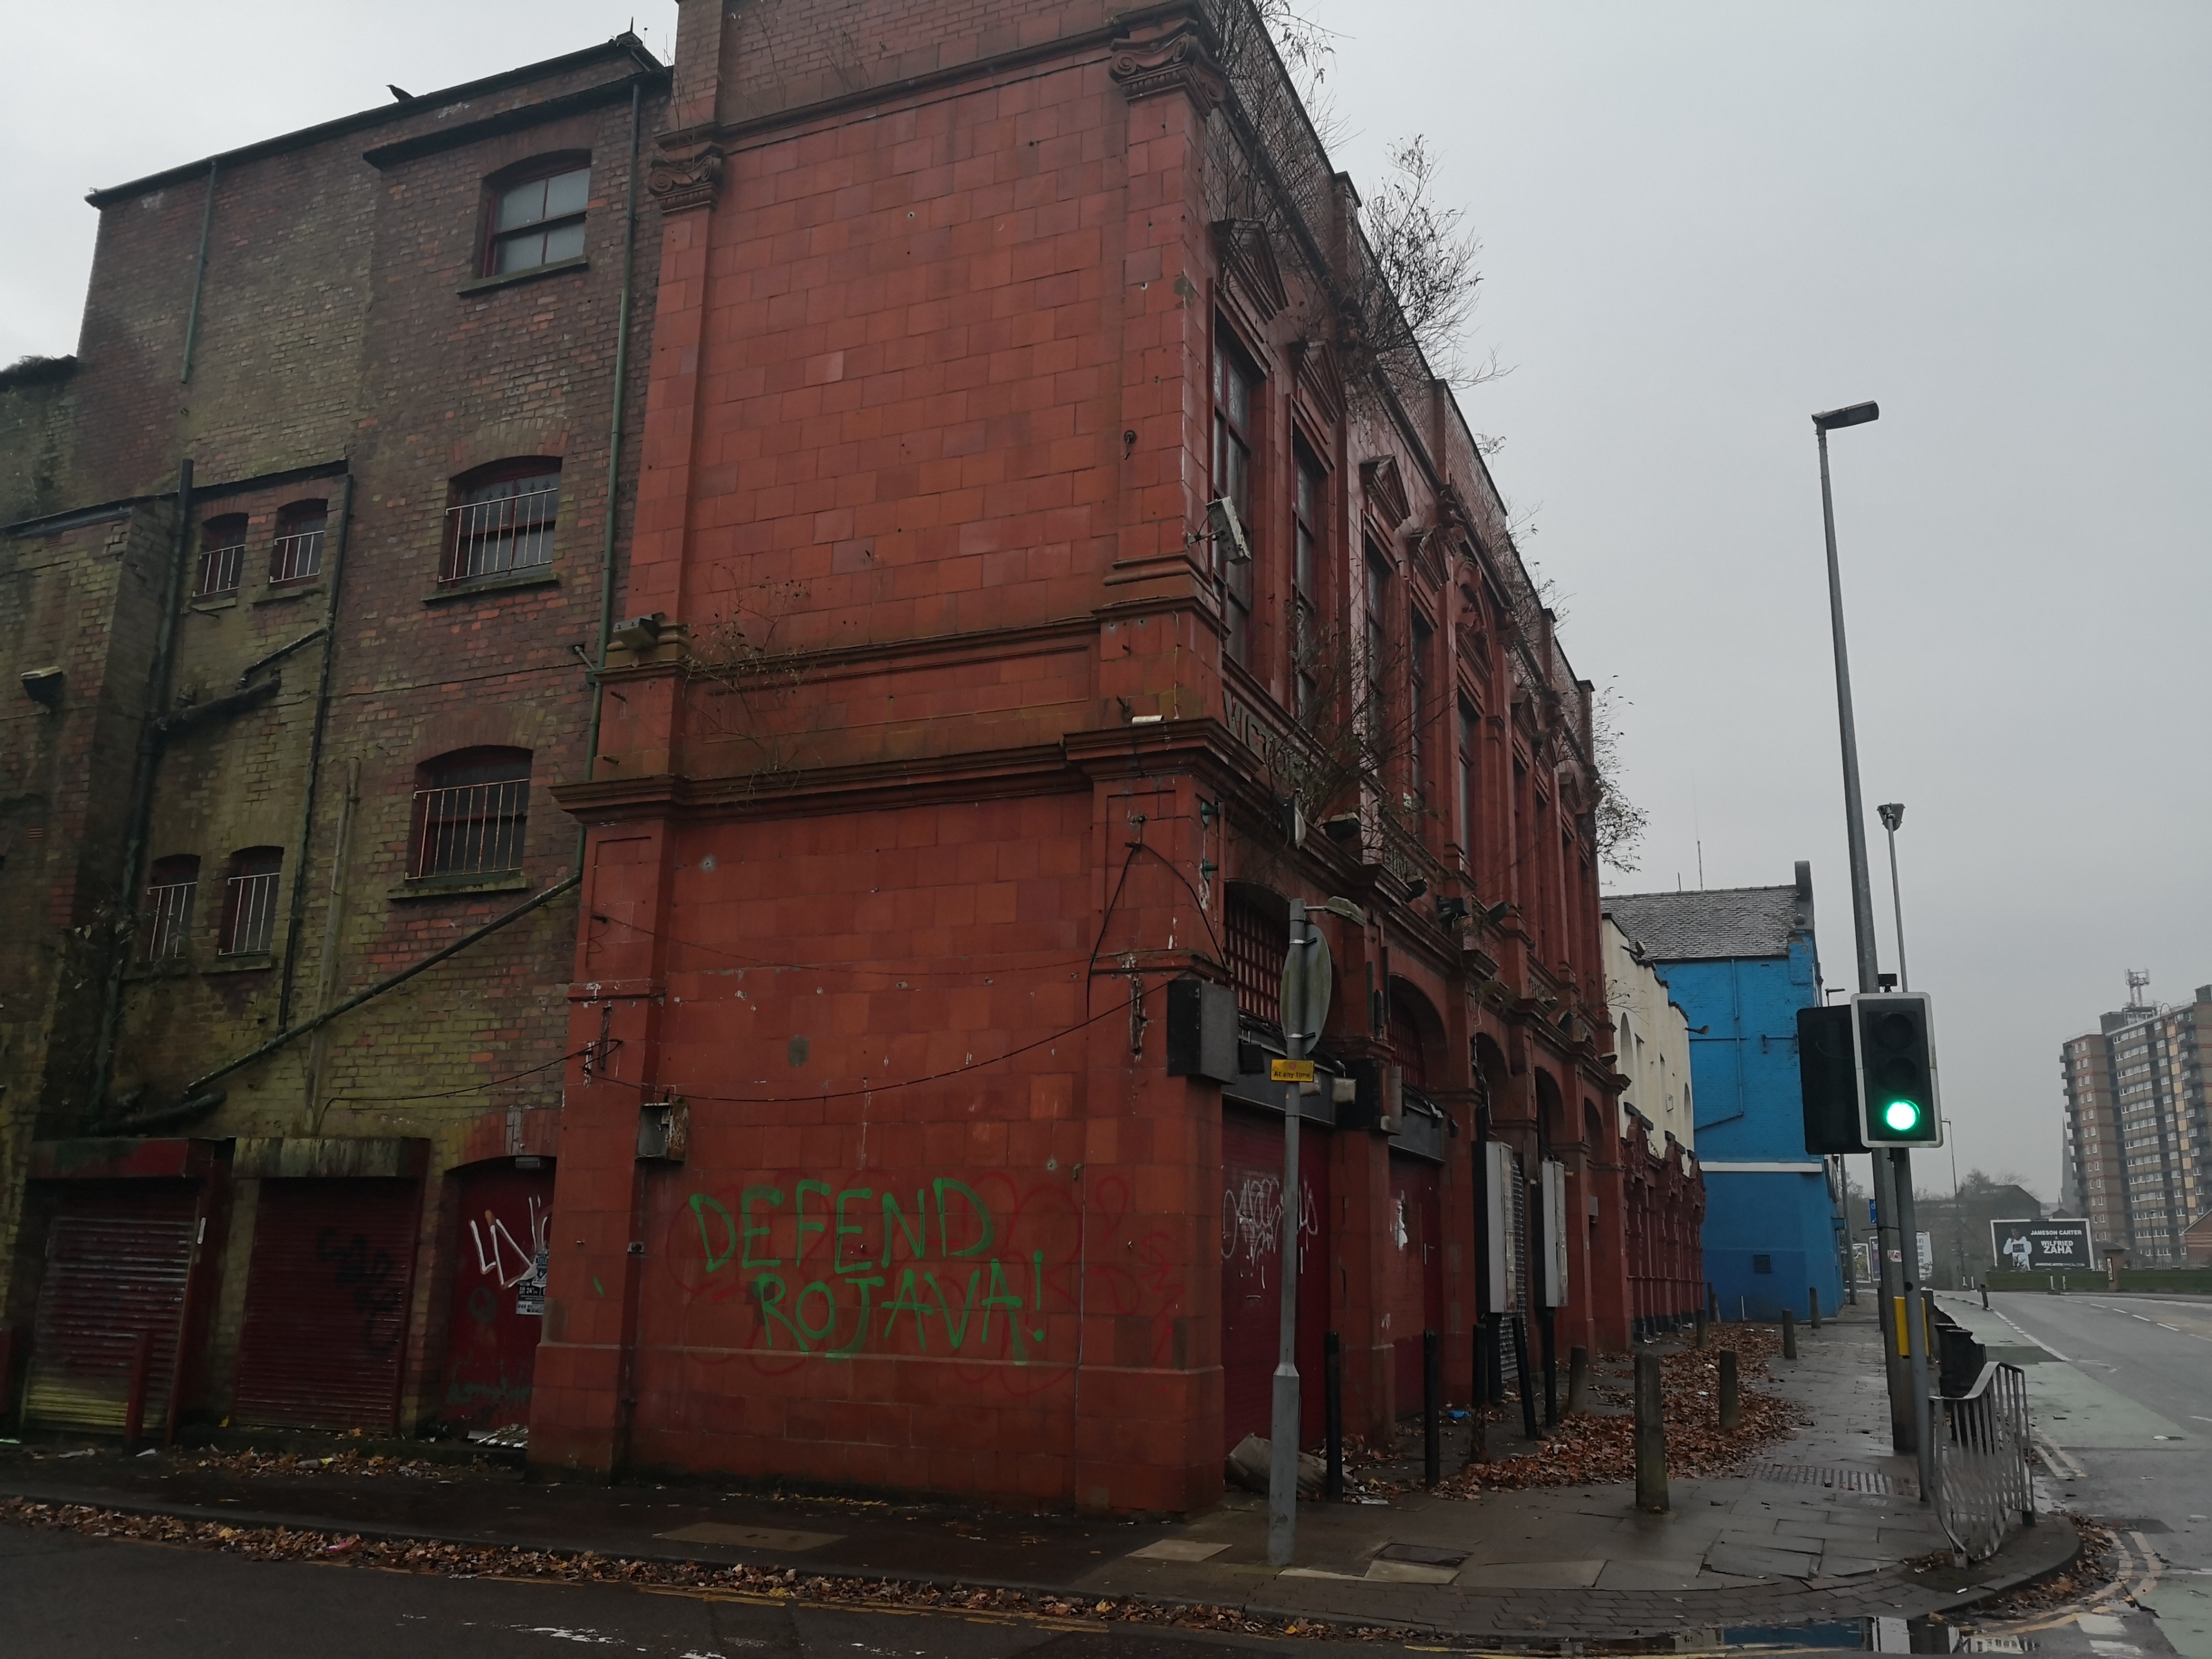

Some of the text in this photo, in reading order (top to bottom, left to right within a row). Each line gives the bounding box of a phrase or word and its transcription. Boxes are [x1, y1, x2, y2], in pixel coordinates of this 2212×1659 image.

[689, 1177, 994, 1274] DEFEND
[2043, 1245, 2072, 1254] ZAHA
[750, 1249, 1044, 1366] ROJAVA!
